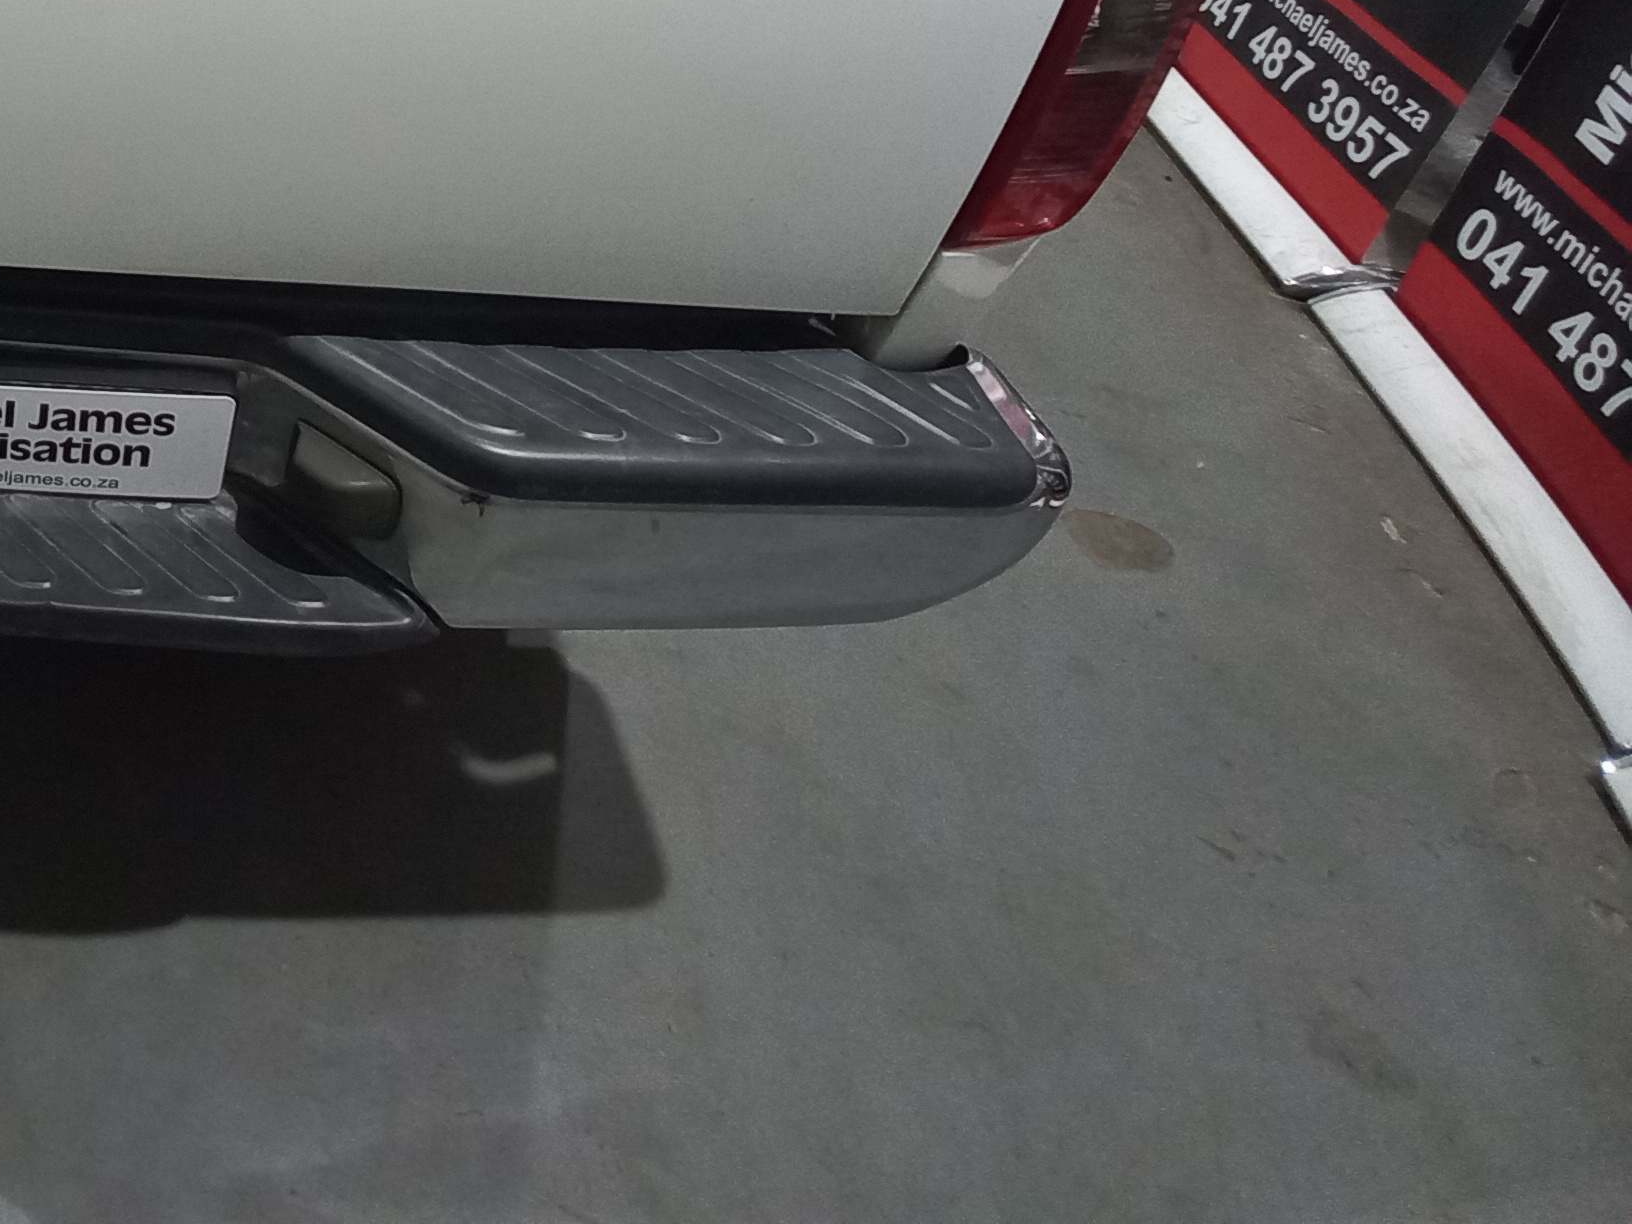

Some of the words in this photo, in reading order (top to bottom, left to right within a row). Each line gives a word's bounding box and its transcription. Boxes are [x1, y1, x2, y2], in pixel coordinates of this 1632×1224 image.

[1248, 24, 1316, 93] 487
[1306, 77, 1413, 180] 3957
[1455, 208, 1549, 316] 041
[27, 402, 176, 438] James
